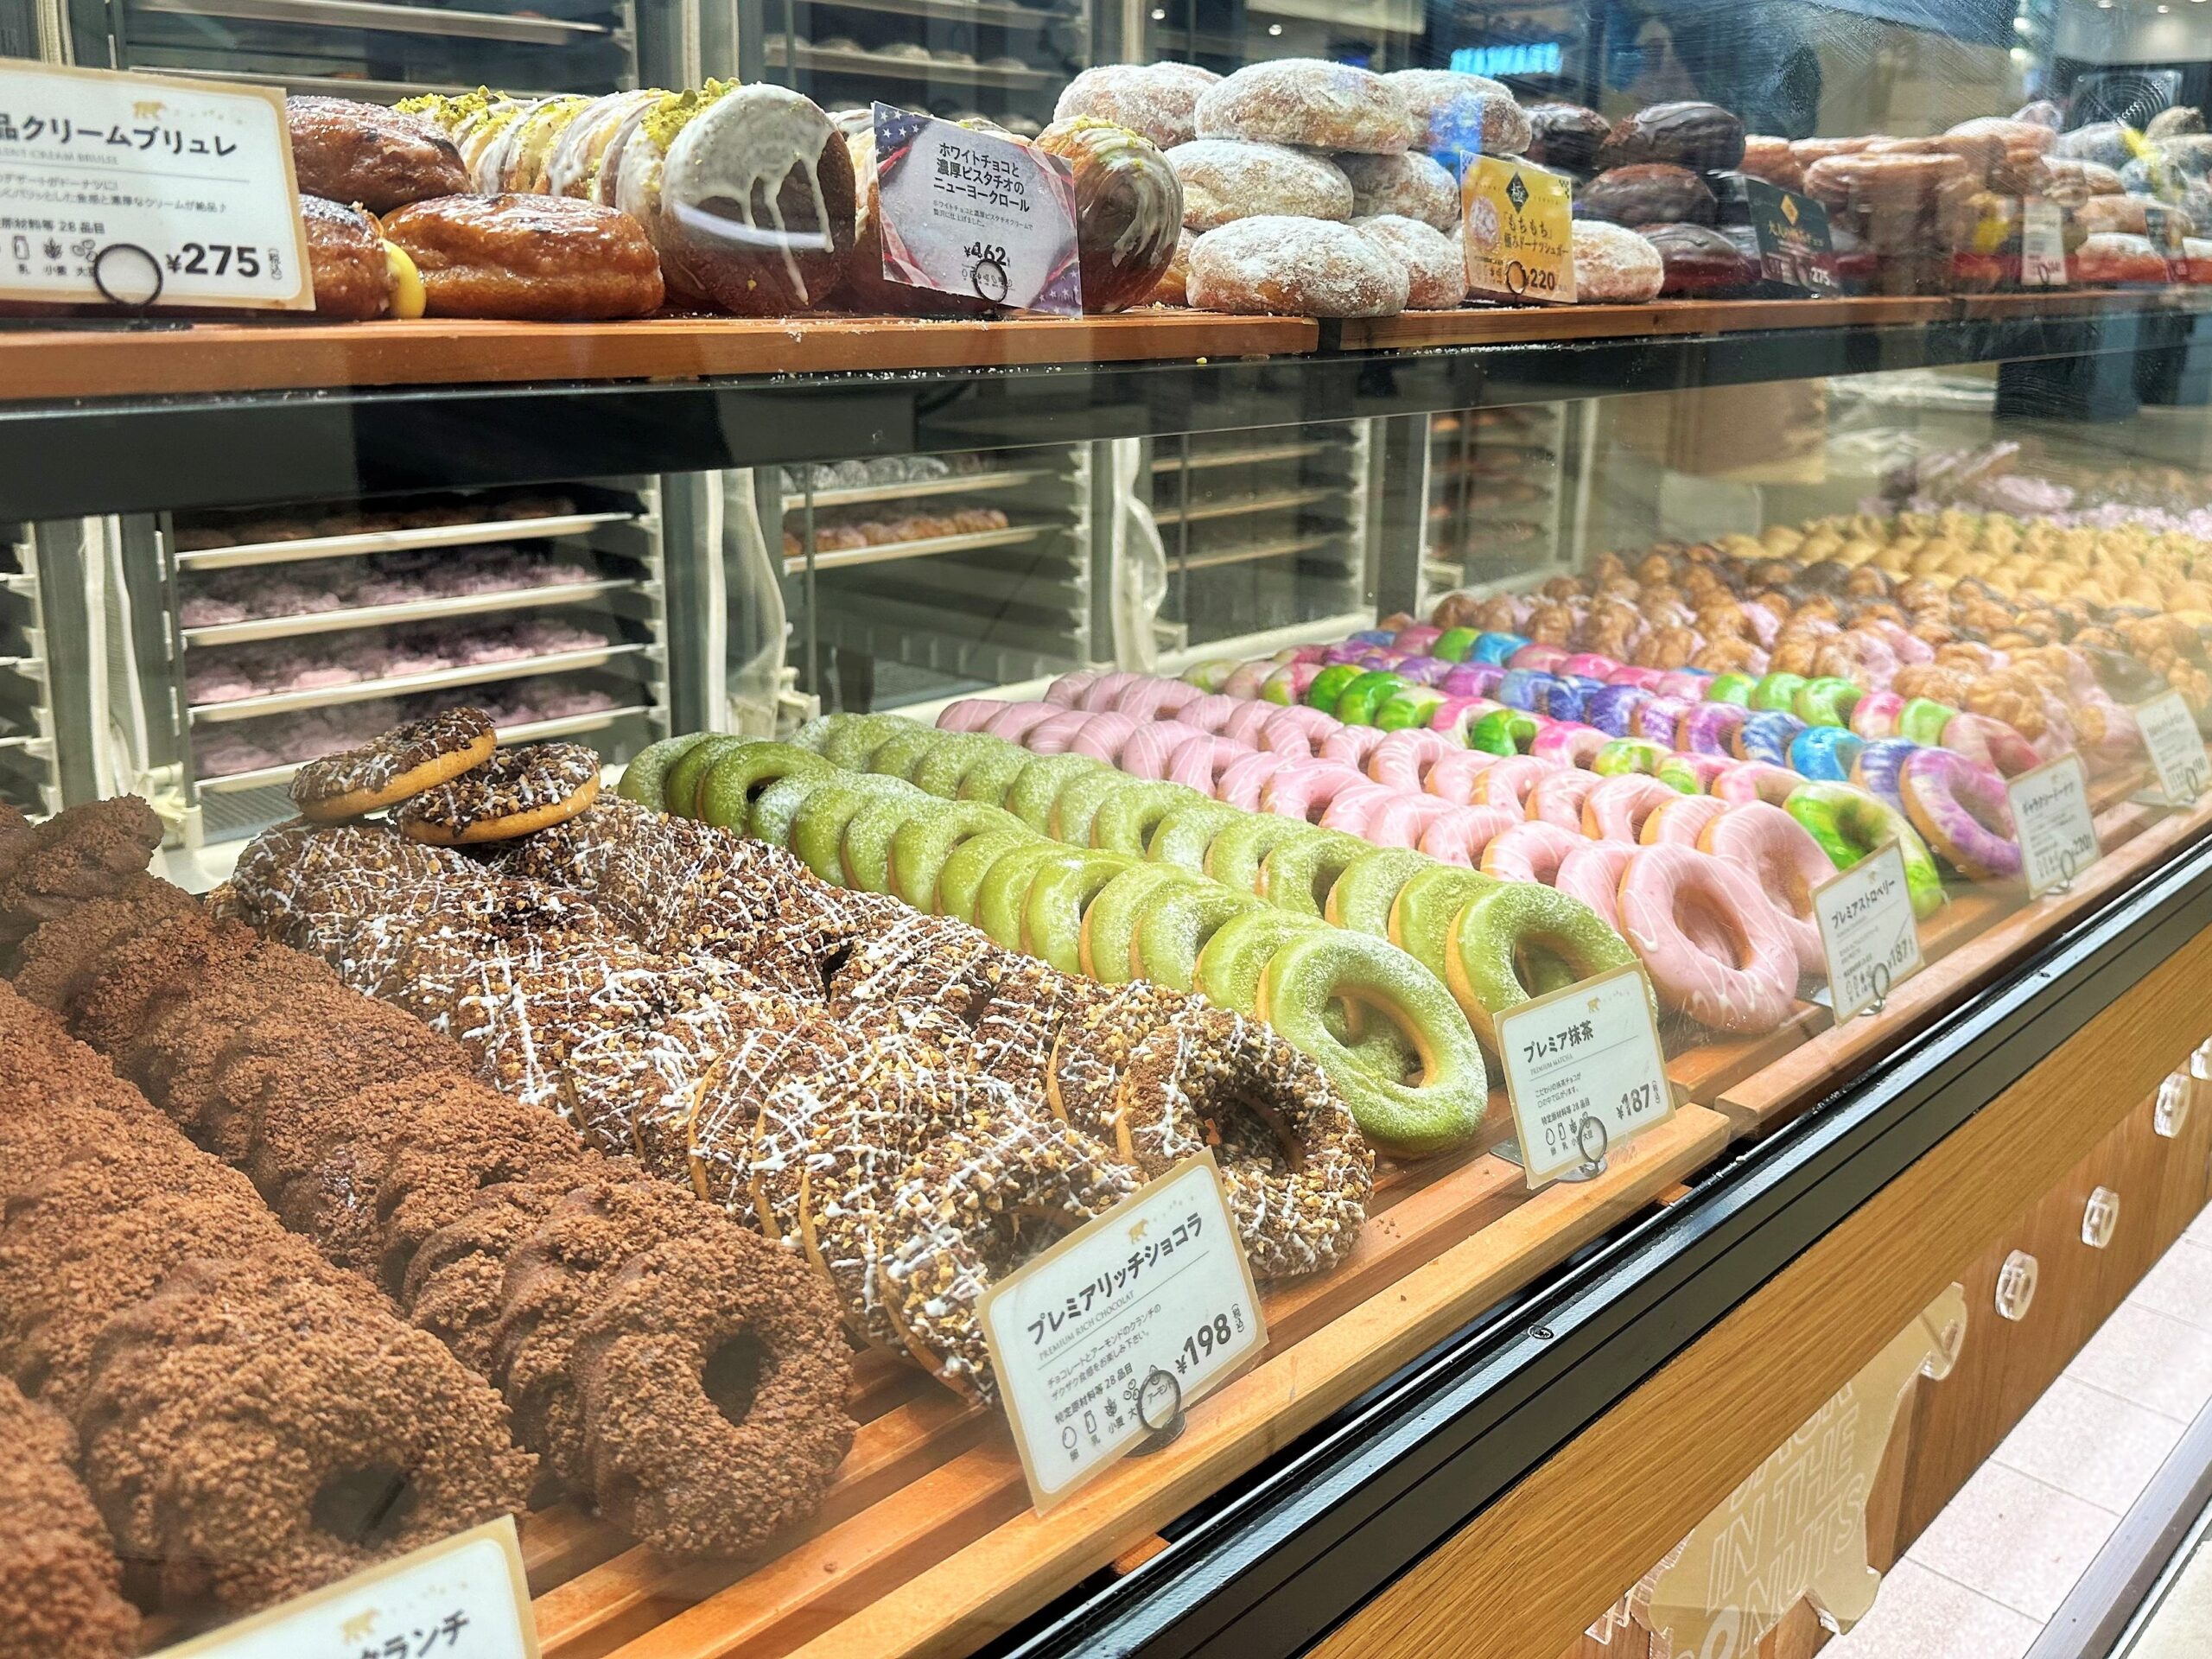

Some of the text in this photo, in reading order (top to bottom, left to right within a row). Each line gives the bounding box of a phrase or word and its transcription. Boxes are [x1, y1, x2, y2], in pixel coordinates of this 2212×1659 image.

[937, 158, 1024, 195] 濃厚ピスタチオの
[939, 142, 1020, 178] ホワイトチョコと
[933, 176, 1030, 213] ニューヨークロール
[166, 243, 260, 278] ¥275
[1831, 879, 1895, 929] プレミアストロベリー
[1523, 1020, 1594, 1064] プレミア抹茶
[1616, 1084, 1649, 1120] ¥187
[1027, 1211, 1202, 1345] プレミアリッチショコラ
[1039, 1290, 1135, 1361] PREMIUM RICH CHOCOLAT
[1175, 1313, 1231, 1374] ¥198
